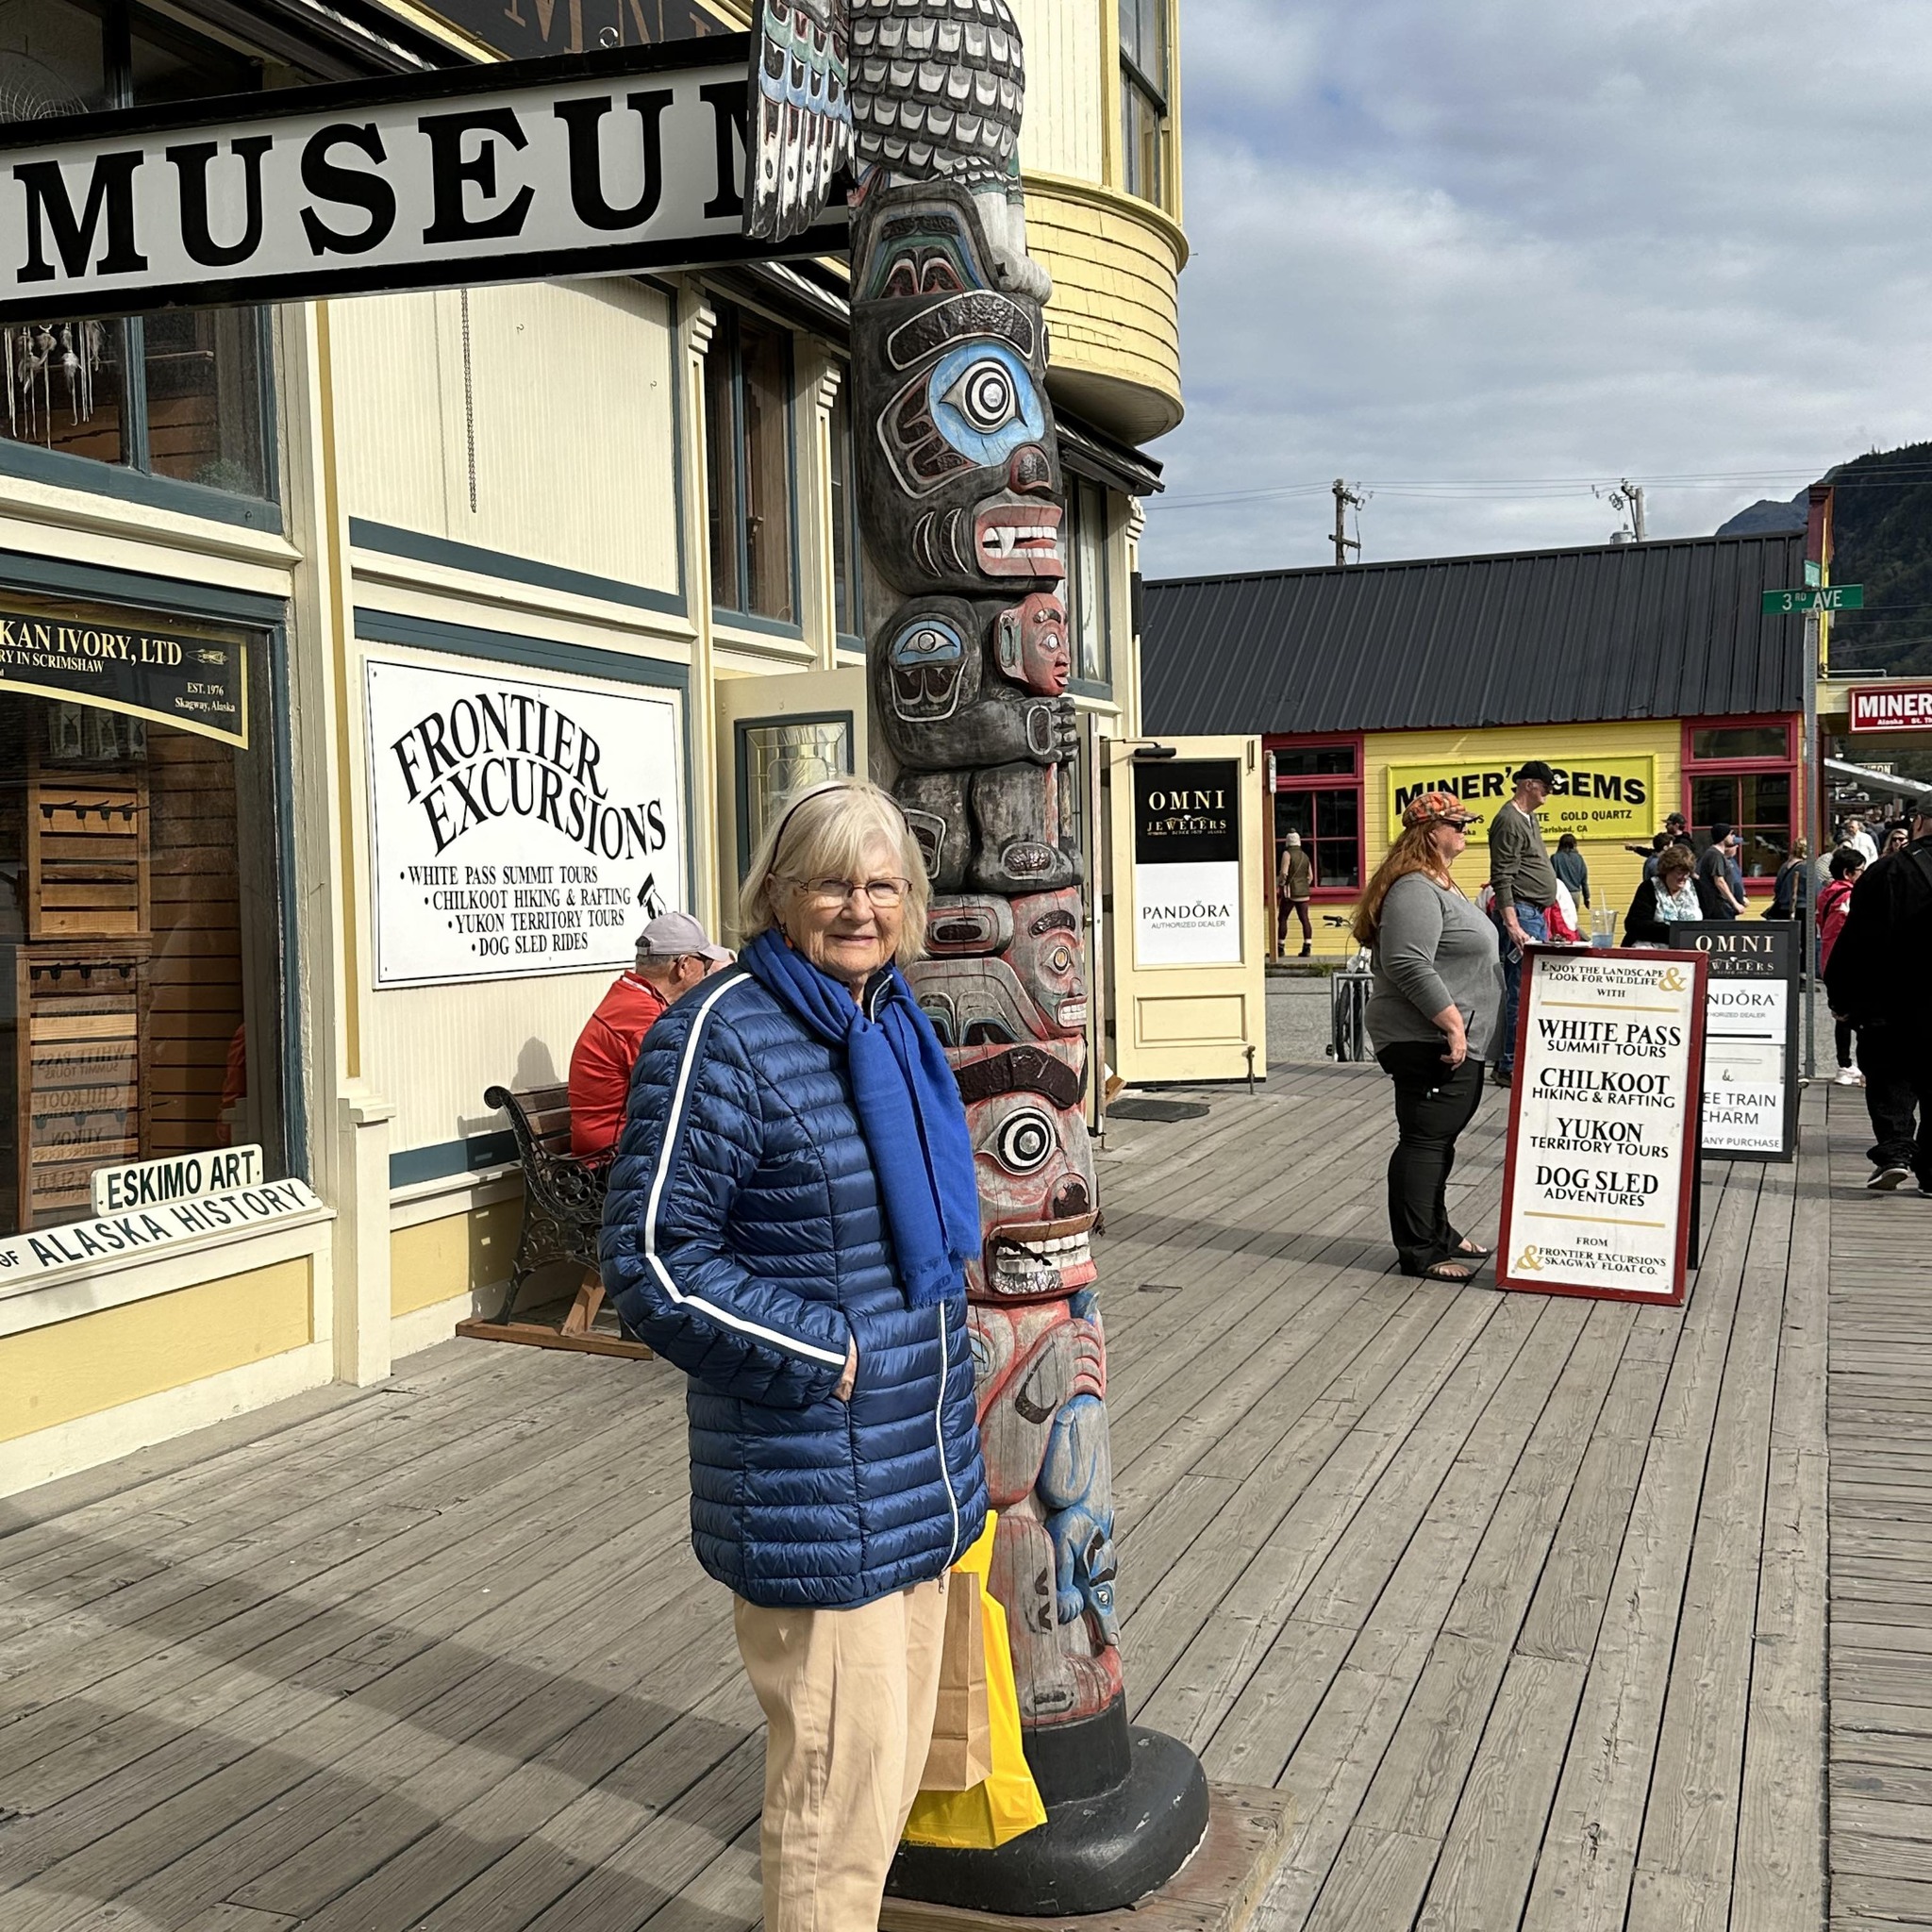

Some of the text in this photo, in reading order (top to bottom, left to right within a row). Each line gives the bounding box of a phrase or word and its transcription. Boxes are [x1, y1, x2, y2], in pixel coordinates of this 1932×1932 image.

[1813, 590, 1843, 611] AVE
[58, 627, 136, 667] IVORY,
[141, 638, 183, 666] LTD
[17, 651, 30, 666] IN
[32, 652, 105, 674] SCRIMSHAW
[187, 682, 225, 696] EST. 1976
[175, 696, 236, 713] Skagway, Alaska
[1858, 693, 1932, 718] MINER
[390, 691, 608, 805] FRONTIER
[1554, 768, 1646, 805] GEMS
[420, 757, 666, 860] EXCURSIONS
[1148, 790, 1225, 810] OMNI
[1147, 819, 1226, 832] JEWELERS
[1561, 810, 1588, 822] GOLD
[1591, 809, 1632, 821] QUARTZ
[1577, 824, 1589, 833] CA
[408, 865, 598, 886] WHITE PASS SUMMIT TOURS
[433, 887, 631, 910] CHILKOOT HIKING & RAFTING
[456, 908, 625, 934] YUKON TERRITORY TOURS
[1151, 920, 1226, 929] AUTHORIZED DEALER
[479, 932, 589, 957] DOG SLED RIDES
[1695, 935, 1774, 953] OMNI
[1541, 961, 1687, 991] ENJOY THE LANDSCAPE &
[1711, 961, 1774, 972] WELERS
[1549, 973, 1657, 986] LOOK FOR WILDLIFE
[1597, 989, 1625, 998] WITH
[1538, 1019, 1681, 1046] WHITE PASS
[1547, 1040, 1666, 1058] SUMMIT TOURS
[1540, 1067, 1671, 1095] CHILKOOT
[1722, 1068, 1735, 1082] &
[1532, 1087, 1675, 1108] HIKING & RAFTING
[1725, 1092, 1776, 1108] TRAIN
[1557, 1117, 1645, 1143] YUKON
[1530, 1136, 1670, 1158] TERRITORY TOURS
[1703, 1137, 1780, 1148] ANY PURCHASE
[108, 1158, 202, 1210] ESKIMO
[209, 1150, 256, 1191] ART
[1535, 1165, 1658, 1194] DOG SLED
[1543, 1187, 1645, 1207] ADVENTURES
[27, 1213, 173, 1267] ALASKA
[171, 1182, 307, 1232] HISTORY
[1575, 1237, 1608, 1247] FROM
[1516, 1244, 1667, 1271] & FRONTIER EXCURSIONS
[1544, 1257, 1658, 1275] SKAGWAY FLOAT CO.
